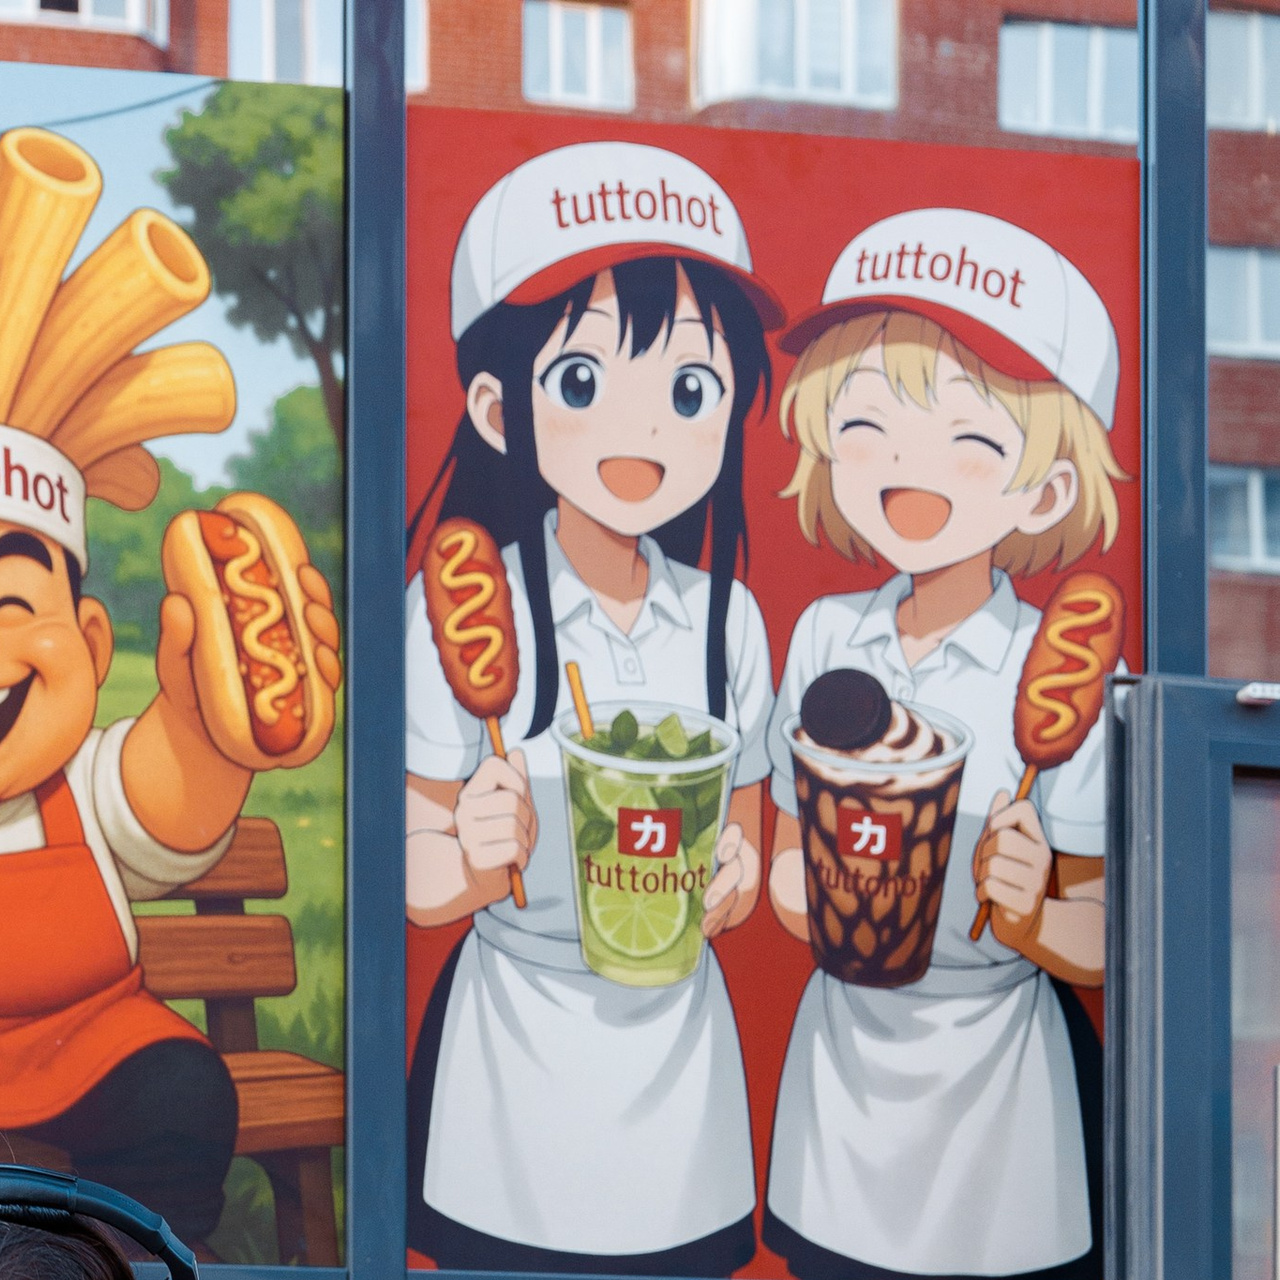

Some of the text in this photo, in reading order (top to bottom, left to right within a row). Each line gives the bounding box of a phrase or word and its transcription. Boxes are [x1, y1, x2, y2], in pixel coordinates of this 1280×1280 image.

[551, 178, 724, 236] tuttohot
[855, 240, 1026, 308] tuttohot
[583, 854, 708, 894] tuttohot
